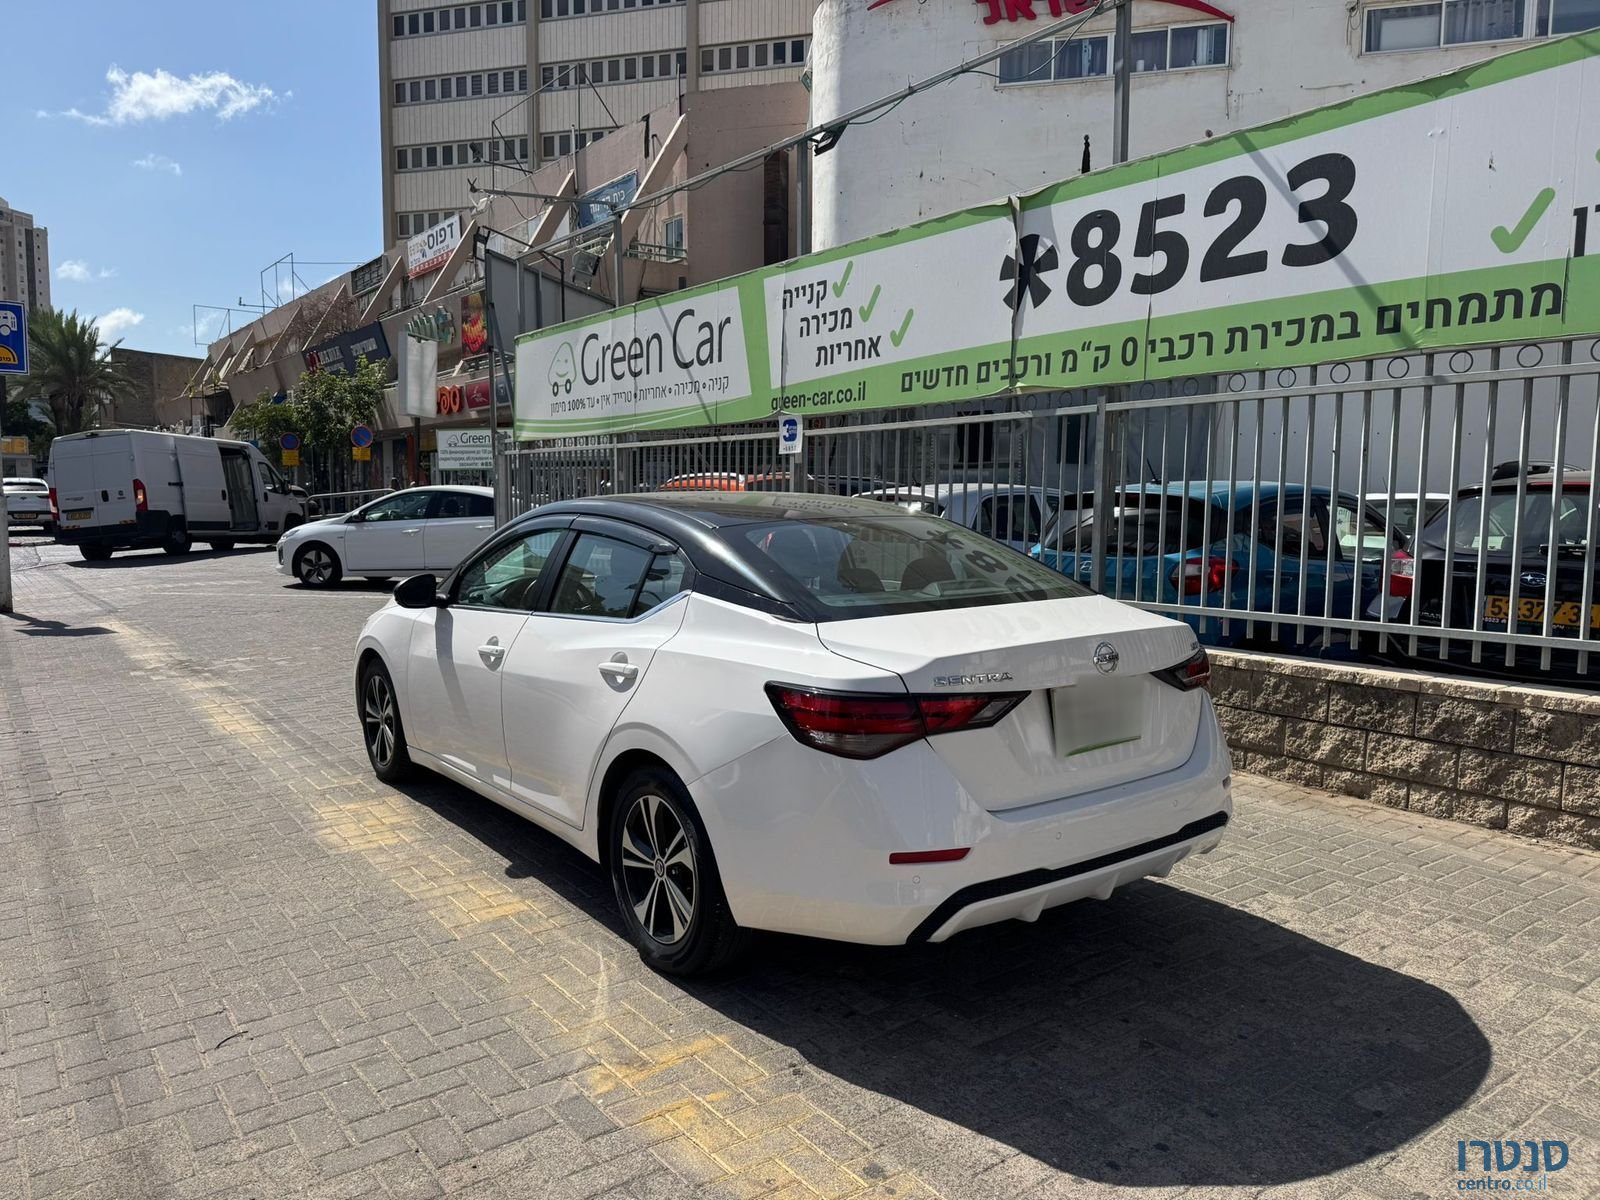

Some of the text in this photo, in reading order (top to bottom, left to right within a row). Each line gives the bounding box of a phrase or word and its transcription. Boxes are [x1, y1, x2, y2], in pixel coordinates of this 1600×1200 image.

[427, 222, 454, 249] דפוס
[783, 280, 828, 309] קנייה
[1376, 282, 1563, 335] מתמחים
[800, 307, 853, 338] מכירה
[1224, 311, 1360, 354] במכירת
[581, 308, 731, 386] Green Car
[815, 335, 882, 367] אחריות
[1121, 336, 1138, 366] 0
[1148, 330, 1213, 361] רכבי
[901, 364, 968, 392] חדשים
[976, 352, 1052, 384] ורכבים
[613, 390, 632, 404] טרייד
[638, 385, 667, 401] אחריות
[674, 381, 700, 396] מכירה
[708, 375, 729, 394] קניה
[550, 400, 566, 416] מימון
[567, 398, 586, 411] 100%
[600, 394, 611, 409] אין
[460, 432, 490, 444] Green
[934, 672, 1014, 687] SENTRA
